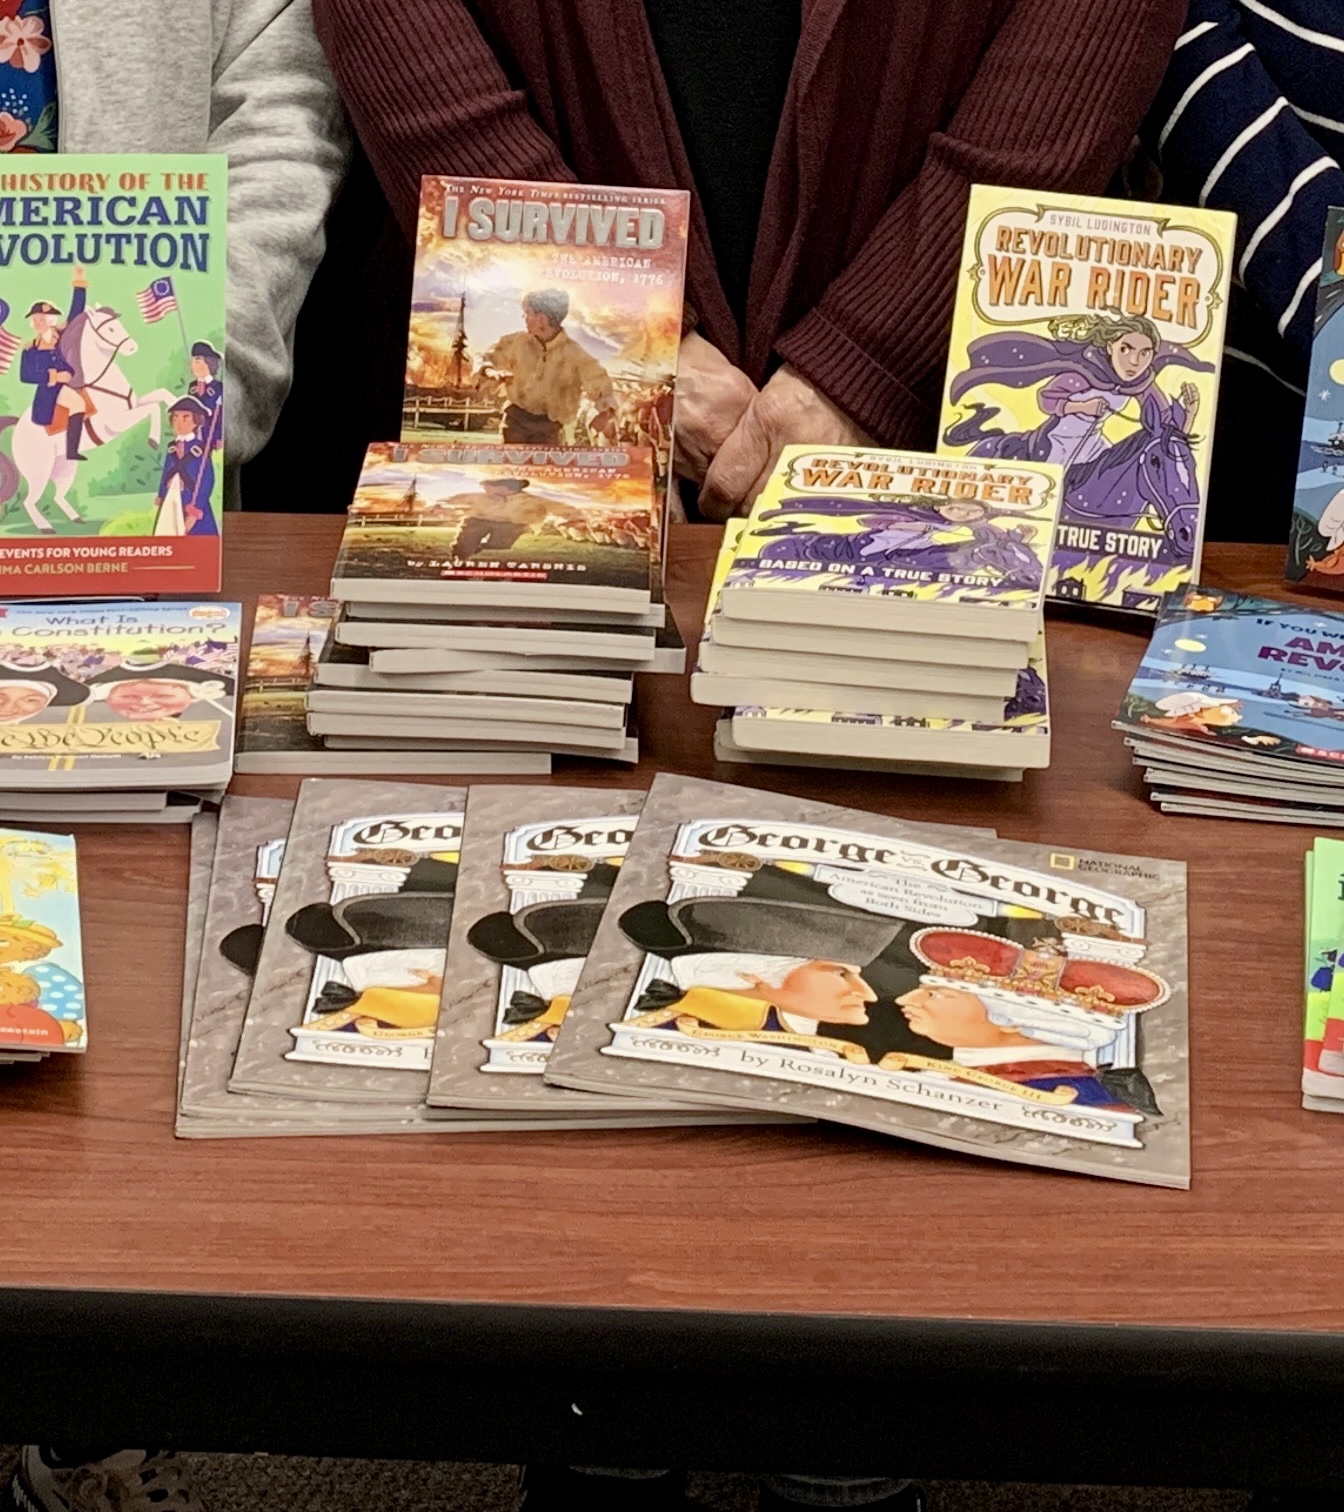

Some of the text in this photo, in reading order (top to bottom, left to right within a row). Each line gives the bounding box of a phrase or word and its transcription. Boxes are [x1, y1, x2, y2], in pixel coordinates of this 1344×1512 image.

[1, 173, 110, 194] HISTORY
[118, 173, 151, 192] OF
[160, 173, 209, 192] THE
[443, 196, 665, 250] I SURVIVED
[1050, 214, 1151, 235] SYBIL LUDINGTON
[996, 226, 1203, 274] REVOLUTIONARY
[988, 254, 1200, 328] WAR RIDER
[46, 547, 70, 558] FOR
[73, 546, 117, 558] YOUNG
[119, 546, 173, 557] READERS
[1058, 525, 1162, 558] TRUE STORY
[24, 563, 84, 574] CARLSON
[87, 563, 128, 573] BERNE
[699, 824, 1124, 925] George George
